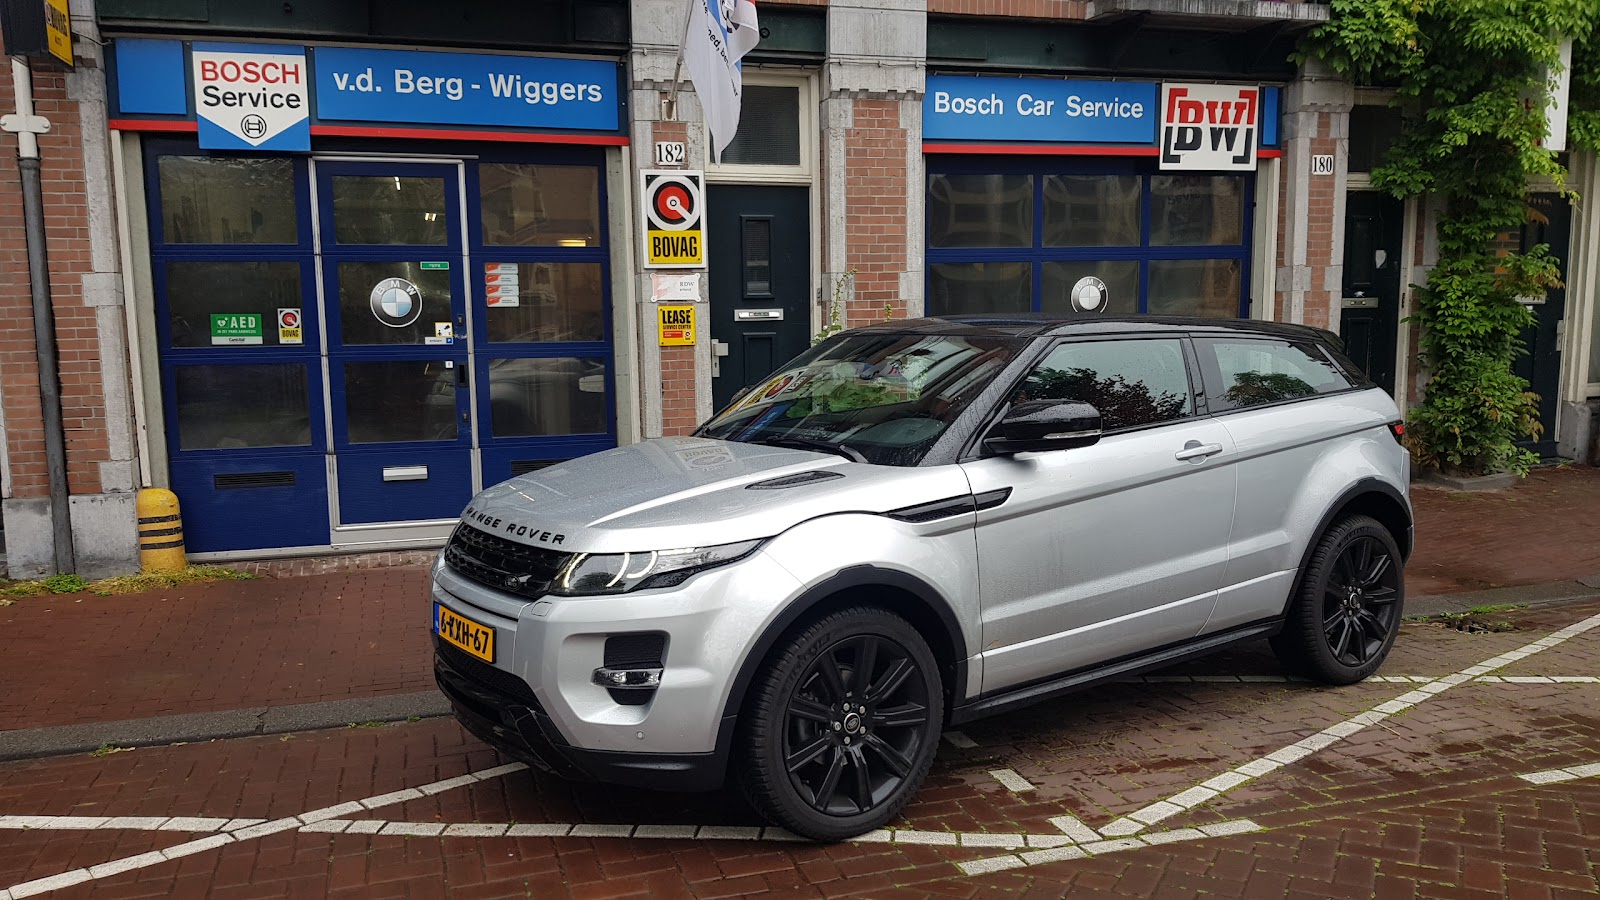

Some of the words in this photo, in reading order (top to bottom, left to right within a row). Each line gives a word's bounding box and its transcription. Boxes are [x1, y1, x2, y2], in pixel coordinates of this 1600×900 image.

[201, 61, 300, 84] BOSCH
[333, 68, 382, 93] v.d.
[395, 69, 463, 100] Berg
[489, 73, 602, 105] Wiggers
[203, 85, 301, 109] Service
[934, 91, 1004, 115] Bosch
[1016, 93, 1055, 116] Car
[1065, 95, 1144, 119] Service
[657, 144, 684, 163] 182
[1313, 156, 1333, 173] 180
[653, 236, 698, 258] BOVAG
[375, 280, 417, 296] BMW
[1076, 278, 1105, 291] BMW
[230, 316, 256, 328] AED
[662, 310, 691, 324] LEASE
[282, 329, 299, 338] BOVAG
[466, 506, 502, 529] RANGE
[506, 523, 566, 545] ROVER
